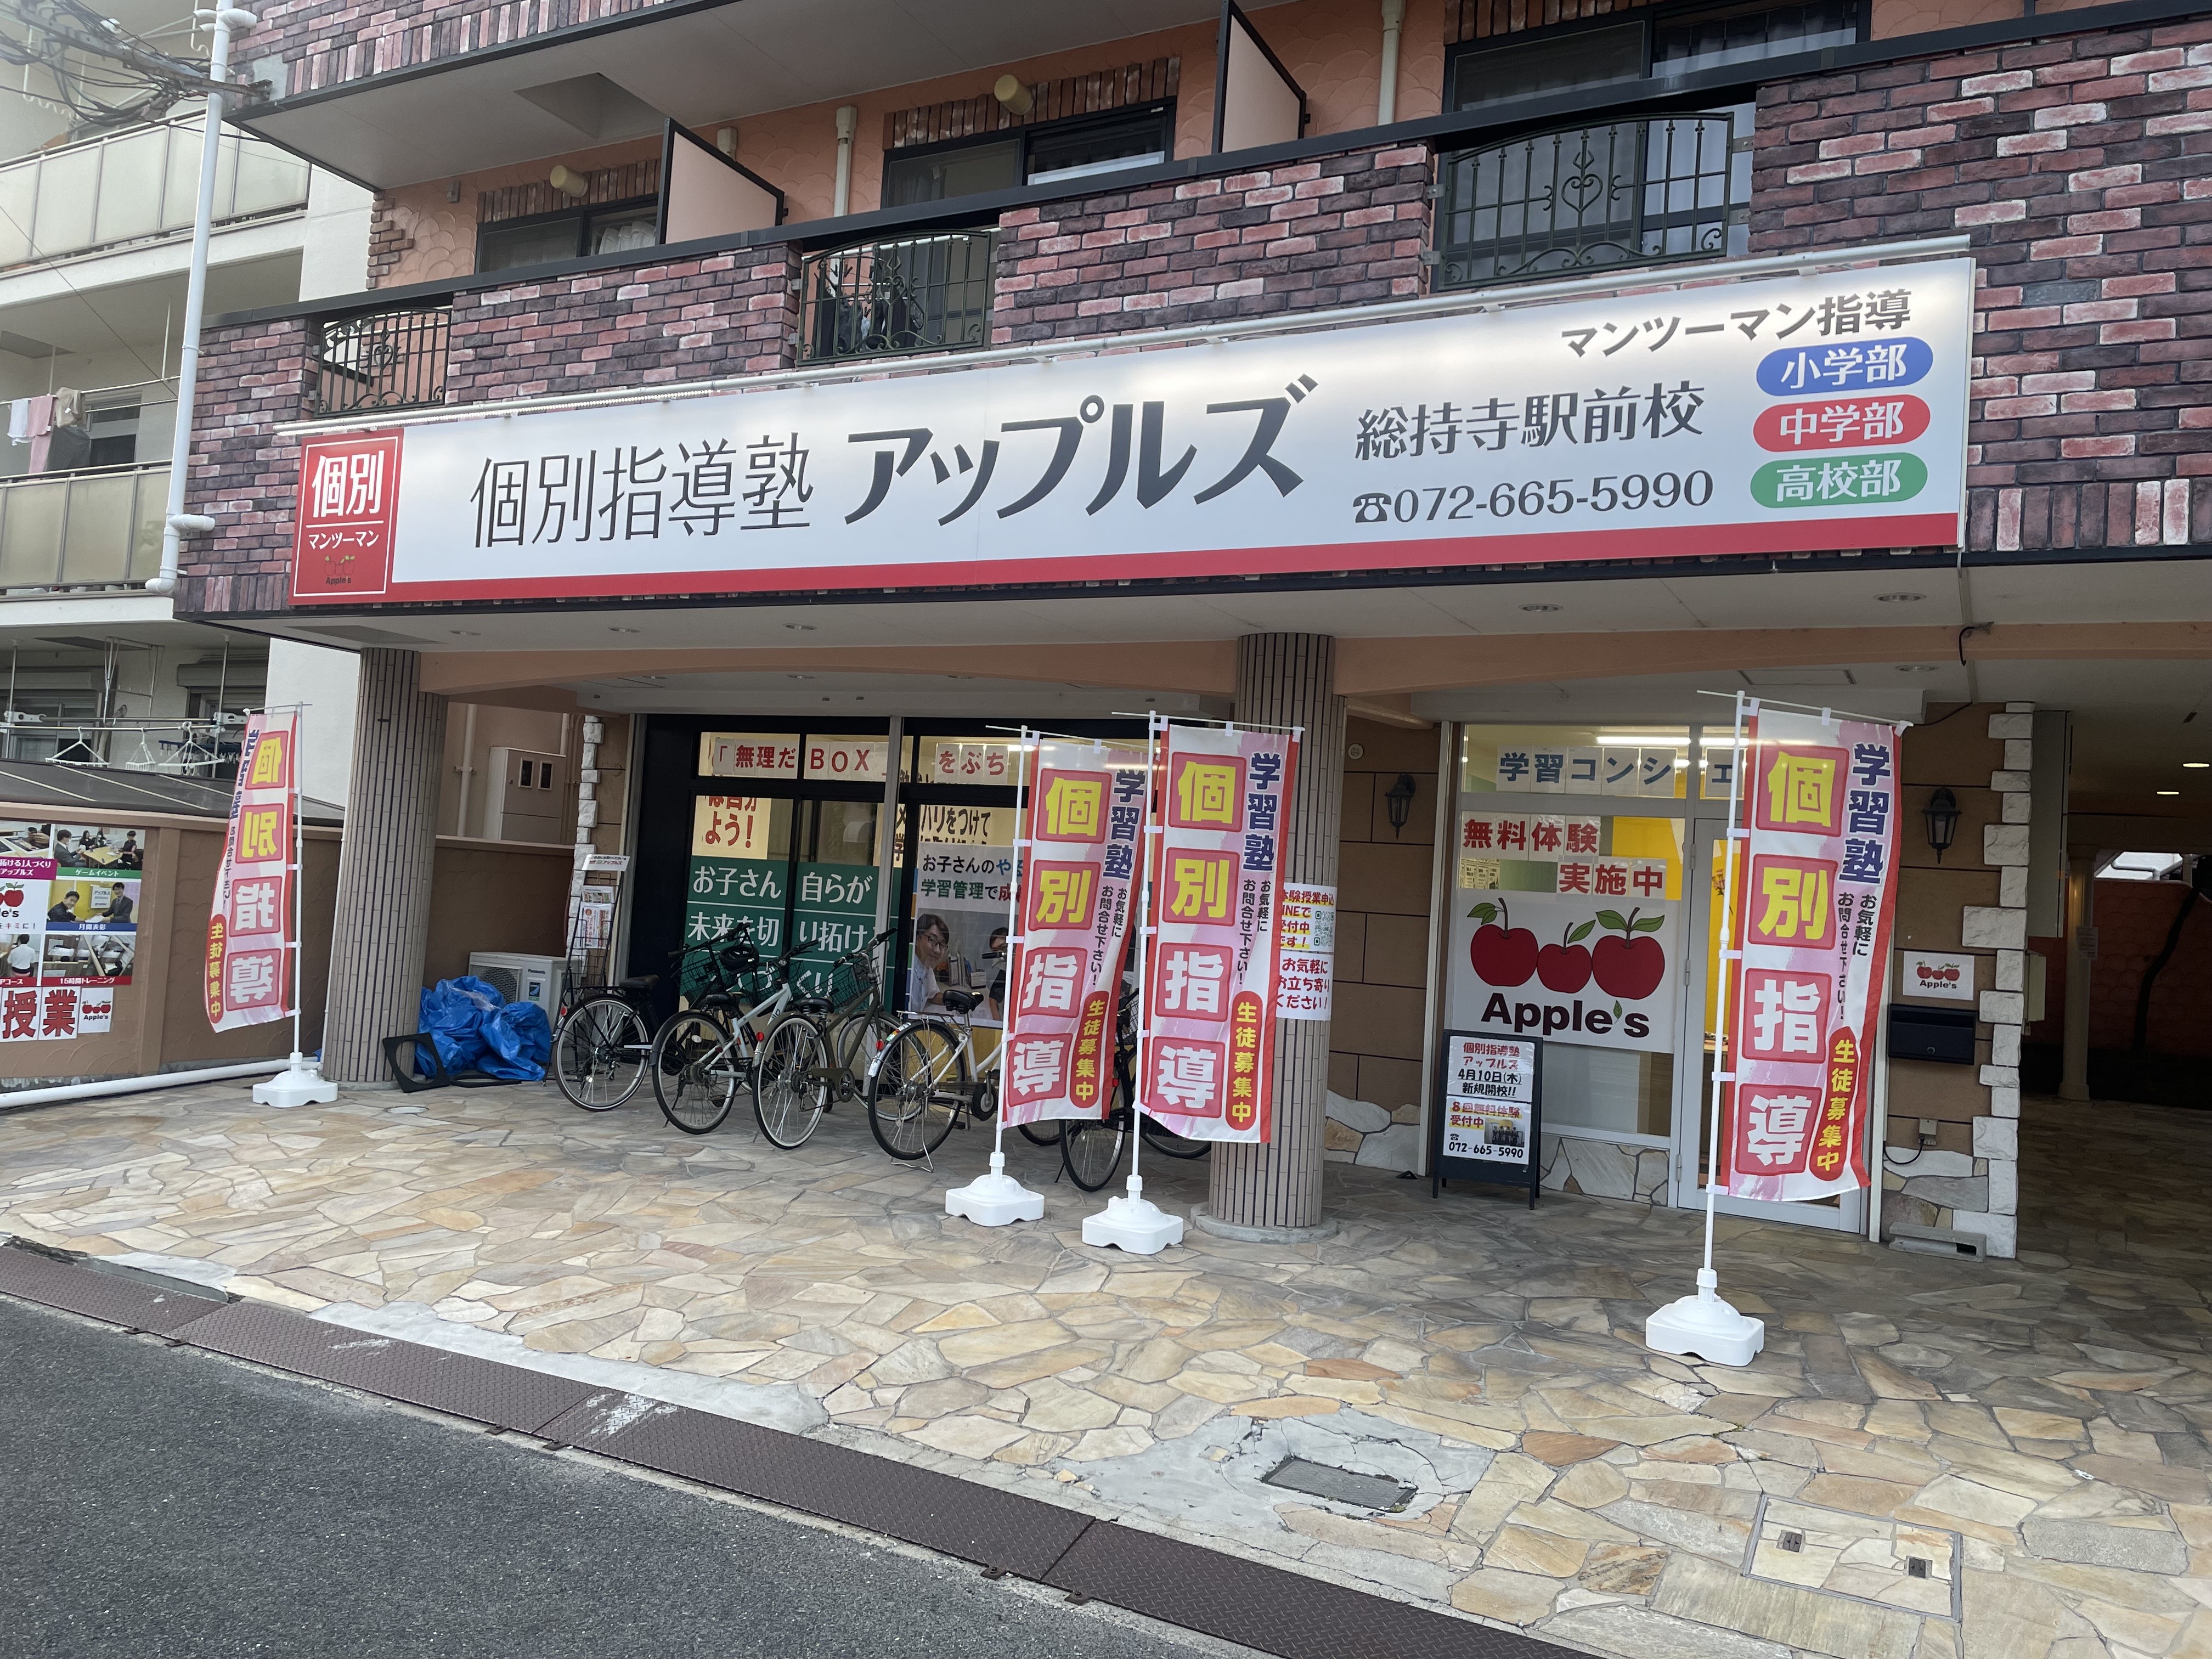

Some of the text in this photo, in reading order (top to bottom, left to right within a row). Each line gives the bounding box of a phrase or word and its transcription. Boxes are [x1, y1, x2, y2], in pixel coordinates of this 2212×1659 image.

[1561, 290, 1912, 358] マンツーマン指導
[1780, 343, 1907, 390] 小学部
[1355, 381, 1706, 461] 総持寺駅前校
[1779, 402, 1904, 445] 中学部
[312, 450, 385, 518] 個別
[470, 374, 1318, 548] 個別指導塾 アップルズ
[1775, 459, 1901, 503] 高校部
[1394, 470, 1713, 523] 072-665-5990
[308, 530, 379, 549] マンツーマン
[939, 751, 1005, 775] をぶち
[1499, 752, 1672, 786] 学習コンシ
[1103, 769, 1146, 880] 学習塾
[1243, 752, 1282, 872] 学習塾
[1463, 818, 1599, 854] 無料体験
[1839, 743, 1891, 884] 学習塾
[75, 869, 120, 877] ゲームイベント
[692, 865, 873, 904] お子さん 自らが
[1558, 862, 1663, 897] 実施中
[0, 907, 20, 917] e's
[1111, 888, 1127, 938] お気軽に
[1257, 880, 1271, 932] お気軽に
[1852, 894, 1877, 956] お気軽に
[1013, 777, 1103, 1096] 個別指導
[1156, 761, 1237, 1108] 個別指導
[1747, 751, 1837, 1167] 個別指導
[1282, 957, 1328, 974] お気軽に
[1919, 979, 1957, 989] Apple's
[2, 989, 77, 1039] 授業
[1481, 992, 1650, 1038] Apple's
[1075, 1000, 1105, 1101] 生徒募集中
[1232, 1002, 1257, 1123] 生徒募集中
[1463, 1042, 1520, 1057] 個別指導塾
[1450, 1114, 1484, 1128] 受付中
[1816, 1039, 1856, 1172] 生徒募集中
[1448, 1142, 1523, 1159] 072-665-5990
